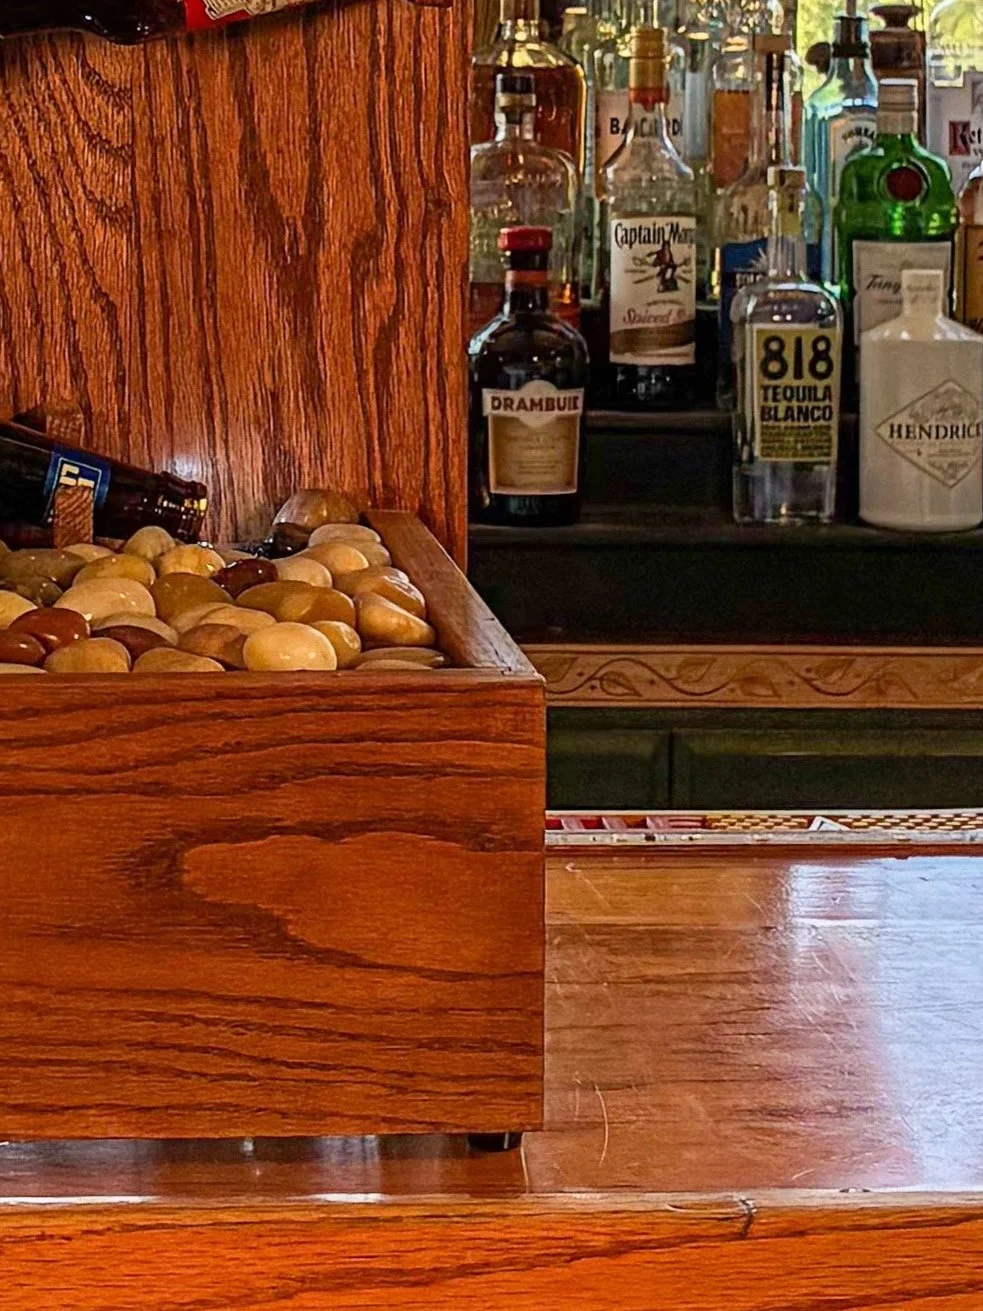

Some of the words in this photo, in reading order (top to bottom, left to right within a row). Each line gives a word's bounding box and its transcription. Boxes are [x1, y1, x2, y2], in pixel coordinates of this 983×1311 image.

[609, 117, 683, 137] BACRDI
[614, 221, 664, 249] Captain
[759, 334, 835, 381] 818
[760, 384, 833, 403] TEQUILA
[490, 395, 580, 412] DRAMBUIE
[760, 405, 834, 423] BLANCO
